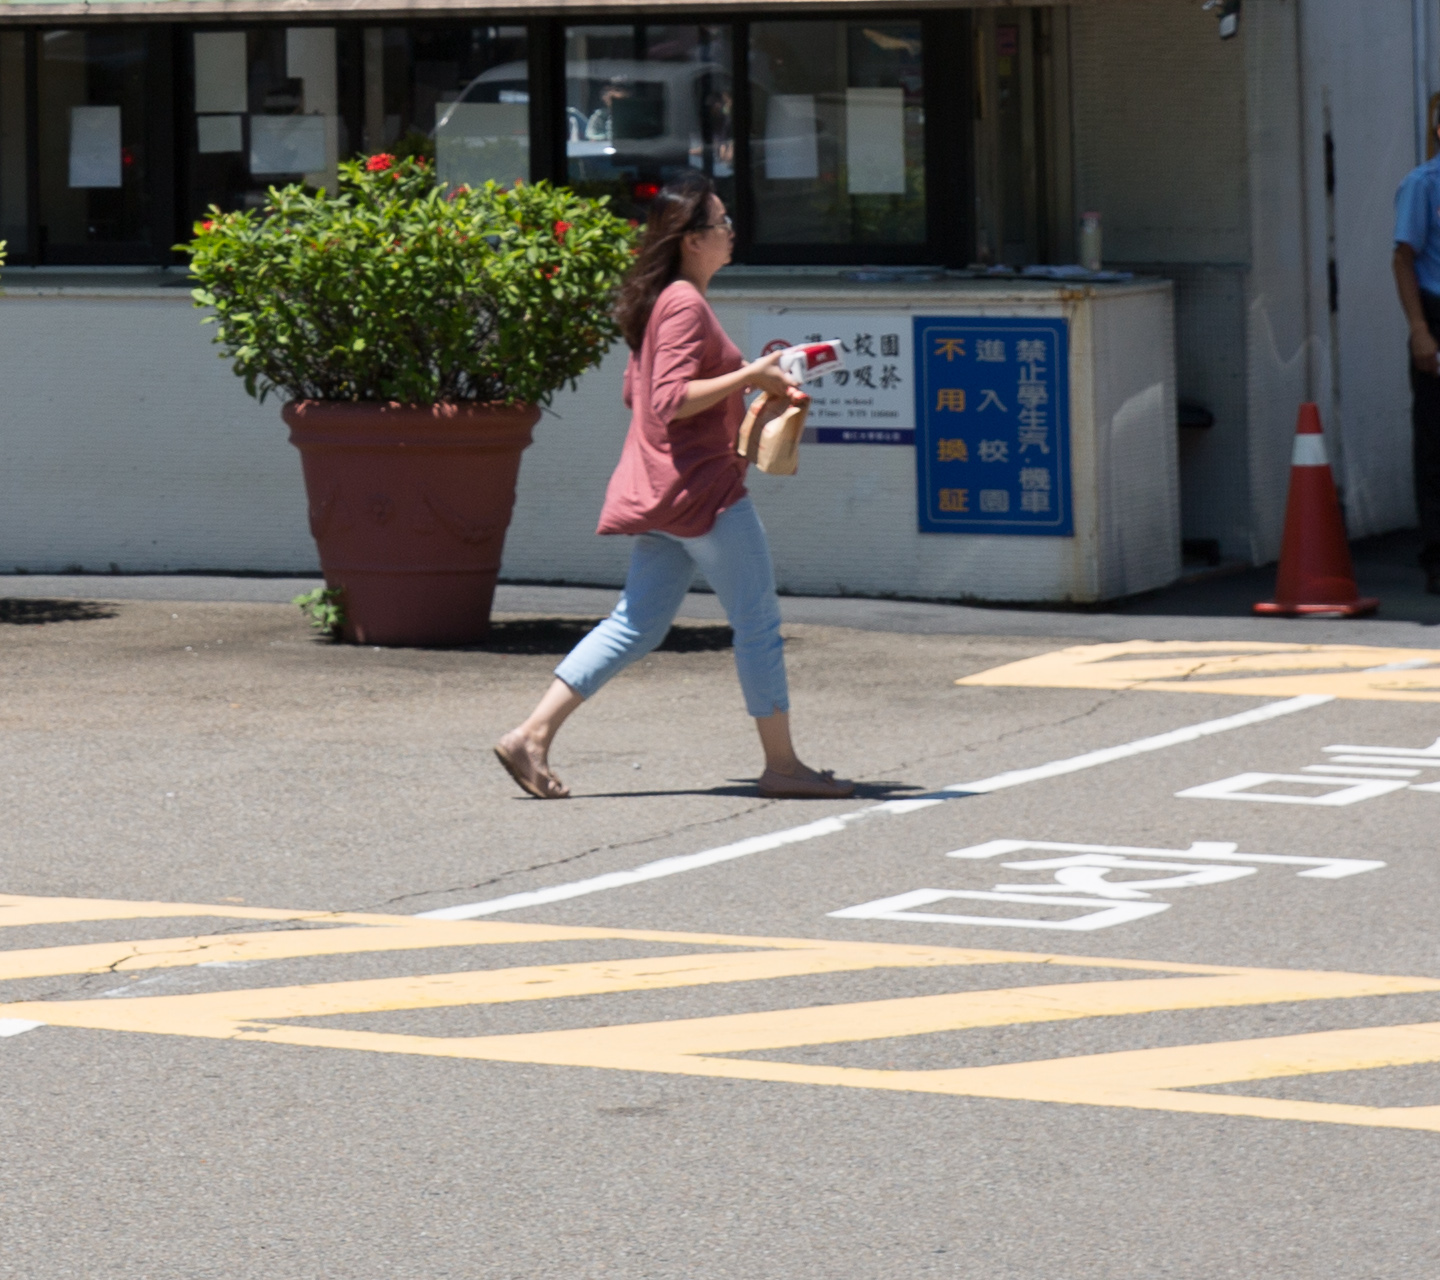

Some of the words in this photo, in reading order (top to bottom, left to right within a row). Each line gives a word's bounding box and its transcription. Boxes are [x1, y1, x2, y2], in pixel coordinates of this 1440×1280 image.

[933, 338, 971, 513] 不用換証
[975, 338, 1010, 513] 進入校園
